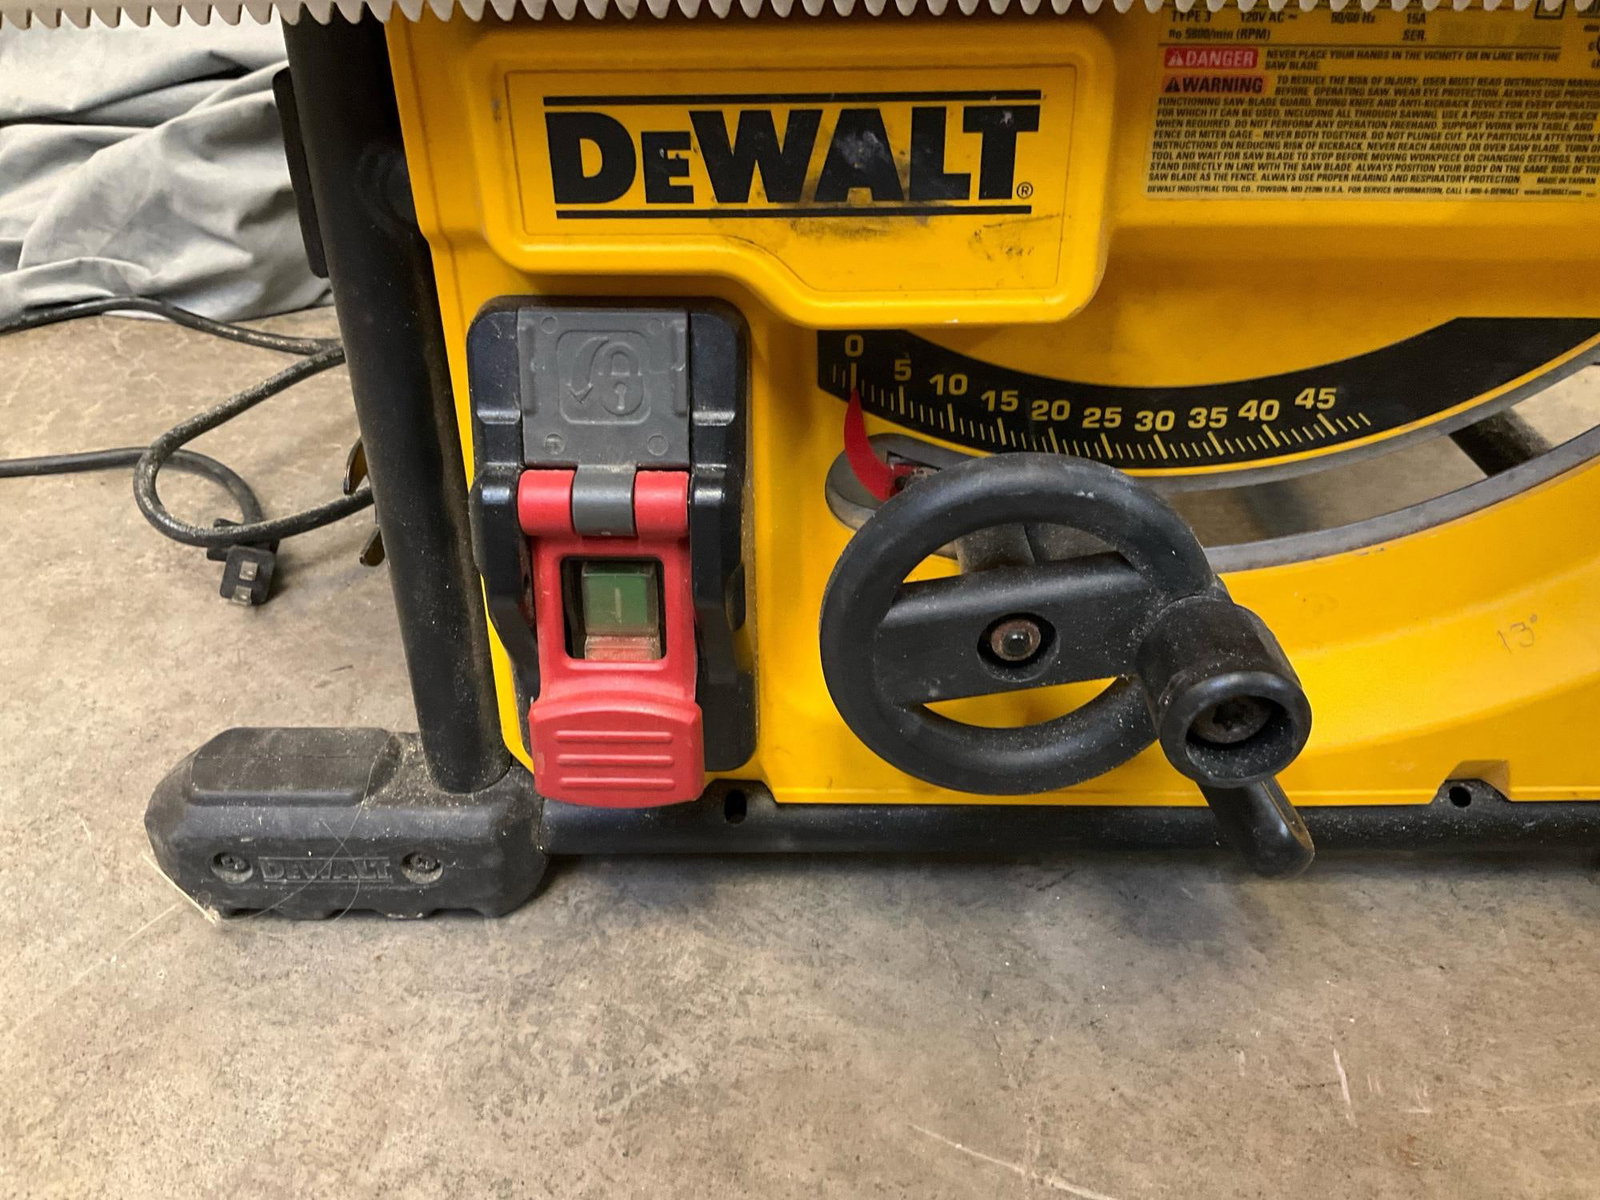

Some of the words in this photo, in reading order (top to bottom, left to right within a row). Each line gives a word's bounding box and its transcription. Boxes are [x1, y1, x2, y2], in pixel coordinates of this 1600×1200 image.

[1236, 29, 1270, 40] (RPM)
[1186, 51, 1254, 67] DANGER
[1183, 78, 1264, 93] WARNING
[1152, 141, 1218, 150] INSTRUCTIONS
[1220, 141, 1233, 150] ON
[1236, 142, 1280, 150] REDUCING
[1283, 142, 1302, 150] RISK
[1306, 142, 1316, 150] OF
[1367, 142, 1396, 150] NEVER
[1398, 143, 1427, 151] REACH
[1429, 143, 1467, 151] AROUND
[1469, 143, 1482, 151] OR
[1483, 143, 1506, 151] OVER
[1508, 143, 1530, 152] SAW
[1565, 144, 1588, 152] TURN
[1152, 152, 1174, 160] TOOL
[1176, 152, 1196, 160] AND
[1198, 152, 1220, 160] WAIT
[1224, 152, 1240, 160] FOR
[1242, 152, 1264, 161] SAW
[1266, 153, 1294, 161] BLADE
[1297, 153, 1308, 161] TO
[1310, 153, 1334, 161] STOP
[1336, 153, 1370, 161] BEFORE
[1371, 153, 1408, 161] MOVING
[1410, 153, 1461, 162] WORKPIECE
[1464, 154, 1476, 162] OR
[1478, 154, 1526, 163] CHANGING
[1149, 173, 1168, 182] SAW
[1170, 173, 1197, 182] BLADE
[1200, 173, 1210, 182] AS
[1214, 173, 1228, 182] THE
[1260, 174, 1296, 182] ALWAYS
[1298, 174, 1314, 182] USE
[1317, 174, 1349, 182] PROPER
[1351, 174, 1388, 182] HEARING
[1390, 174, 1409, 182] AND
[1410, 175, 1466, 183] RESPIRATORY
[1469, 175, 1520, 184] PROTECTION
[1150, 163, 1180, 171] STAND
[1182, 163, 1222, 171] DIRECTLY
[1224, 163, 1234, 171] IN
[1236, 163, 1254, 172] LINE
[1257, 163, 1280, 172] WITH
[1283, 163, 1298, 172] THE
[1301, 163, 1322, 172] SAW
[1356, 164, 1394, 172] ALWAYS
[1396, 164, 1436, 173] POSITION
[1439, 165, 1462, 173] YOUR
[1464, 165, 1488, 173] BODY
[1490, 165, 1503, 173] ON
[1506, 165, 1521, 174] THE
[1523, 165, 1548, 174] SAME
[1550, 166, 1570, 174] SIDE
[1572, 166, 1583, 174] OF
[844, 334, 865, 358] 0
[894, 359, 912, 382] 5
[929, 374, 969, 396] 10
[981, 390, 1020, 413] 15
[1295, 387, 1337, 409] 45
[1031, 399, 1071, 421] 20
[1082, 407, 1122, 429] 25
[1135, 410, 1175, 432] 30
[1188, 407, 1229, 429] 35
[1238, 399, 1280, 422] 40
